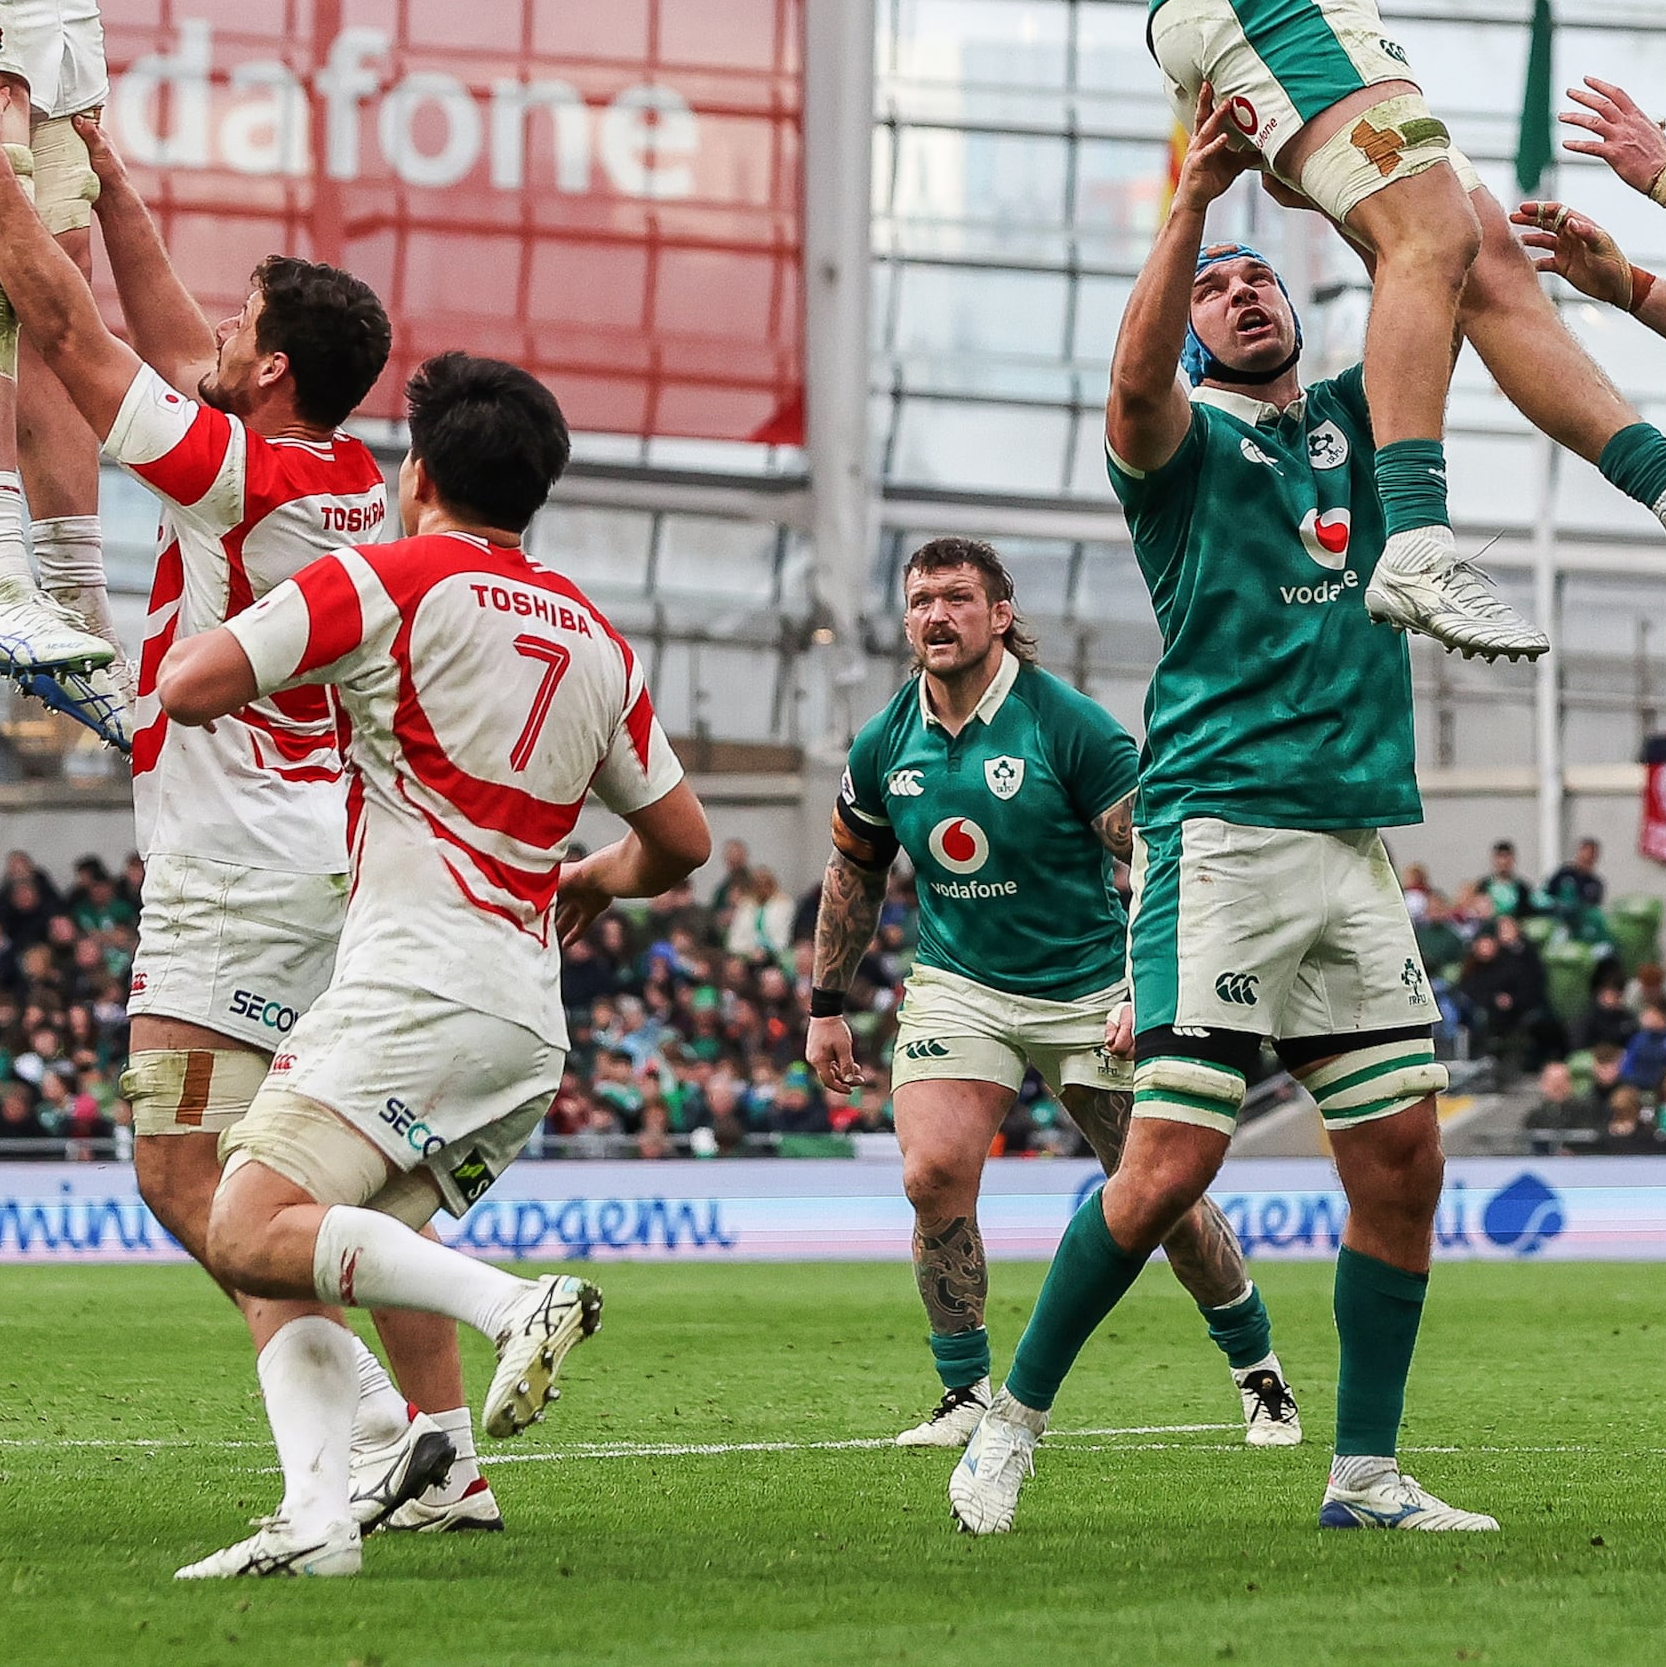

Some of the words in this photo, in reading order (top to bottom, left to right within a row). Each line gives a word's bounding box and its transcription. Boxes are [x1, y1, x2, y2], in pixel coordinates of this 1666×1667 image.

[116, 16, 701, 200] dafone
[469, 584, 593, 640] TOSHIBA
[509, 633, 572, 773] 7
[930, 880, 1018, 899] vodafone
[228, 989, 300, 1033] SECO
[378, 1097, 446, 1159] SECO
